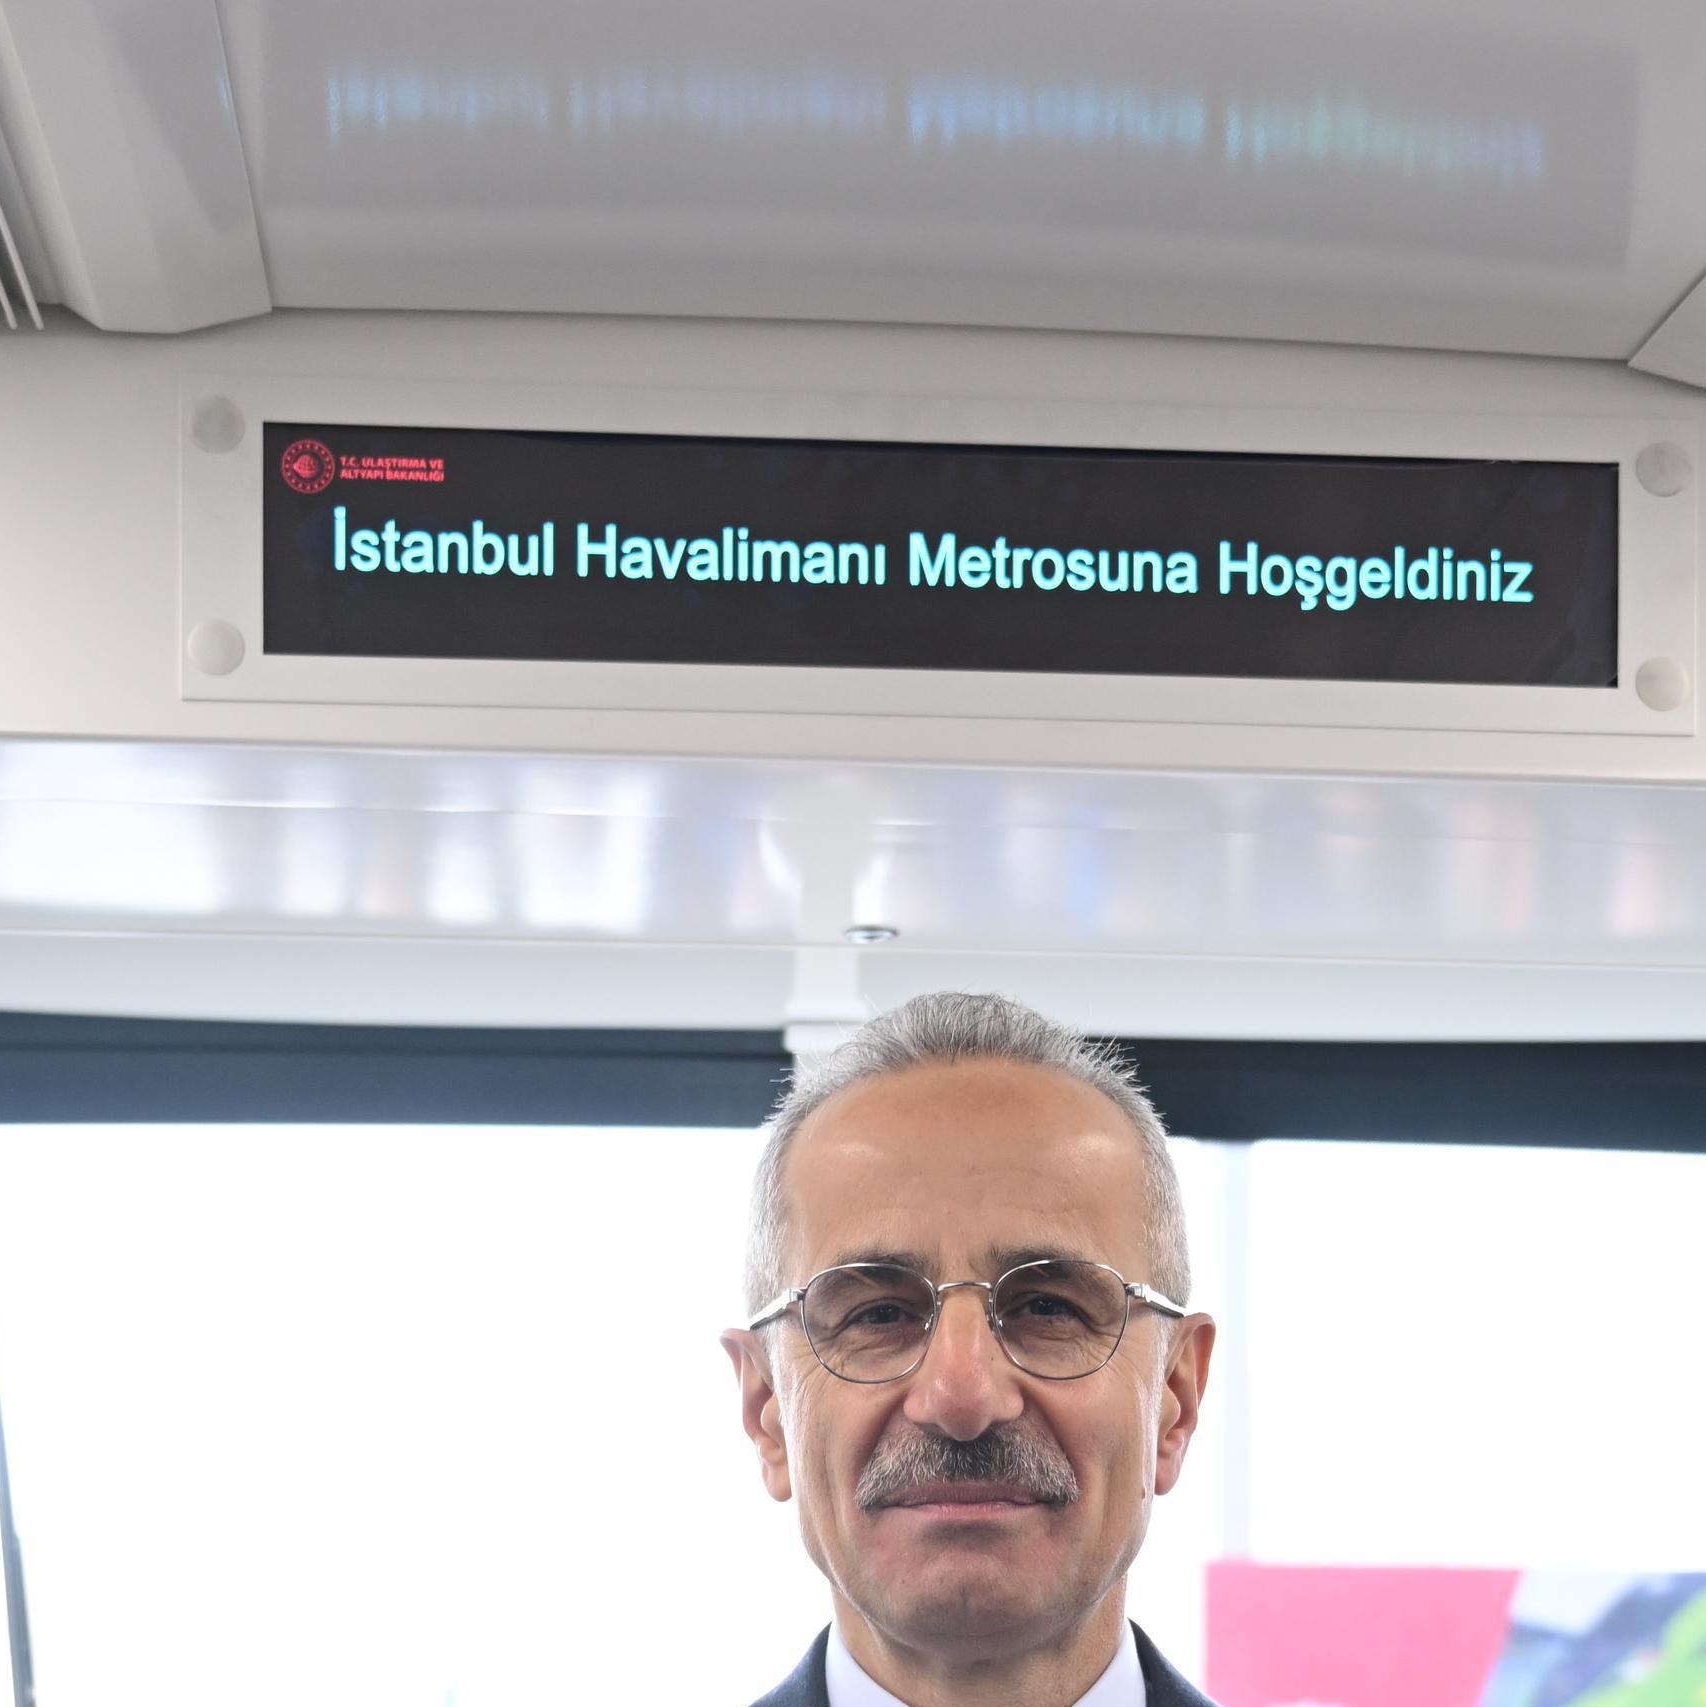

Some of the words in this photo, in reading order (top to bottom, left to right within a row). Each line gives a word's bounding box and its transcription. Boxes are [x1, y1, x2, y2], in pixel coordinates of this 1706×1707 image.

[340, 456, 359, 467] T.C.
[362, 457, 426, 470] ULAŞTIRMA
[429, 459, 444, 469] VE
[340, 469, 384, 480] ALTYAPI
[386, 469, 445, 481] BAKANLIĞI
[334, 505, 555, 577] İstanbul
[576, 522, 886, 585] Havalimanı
[909, 531, 1198, 594] Metrosuna
[1219, 540, 1534, 611] Hoşgeldiniz
